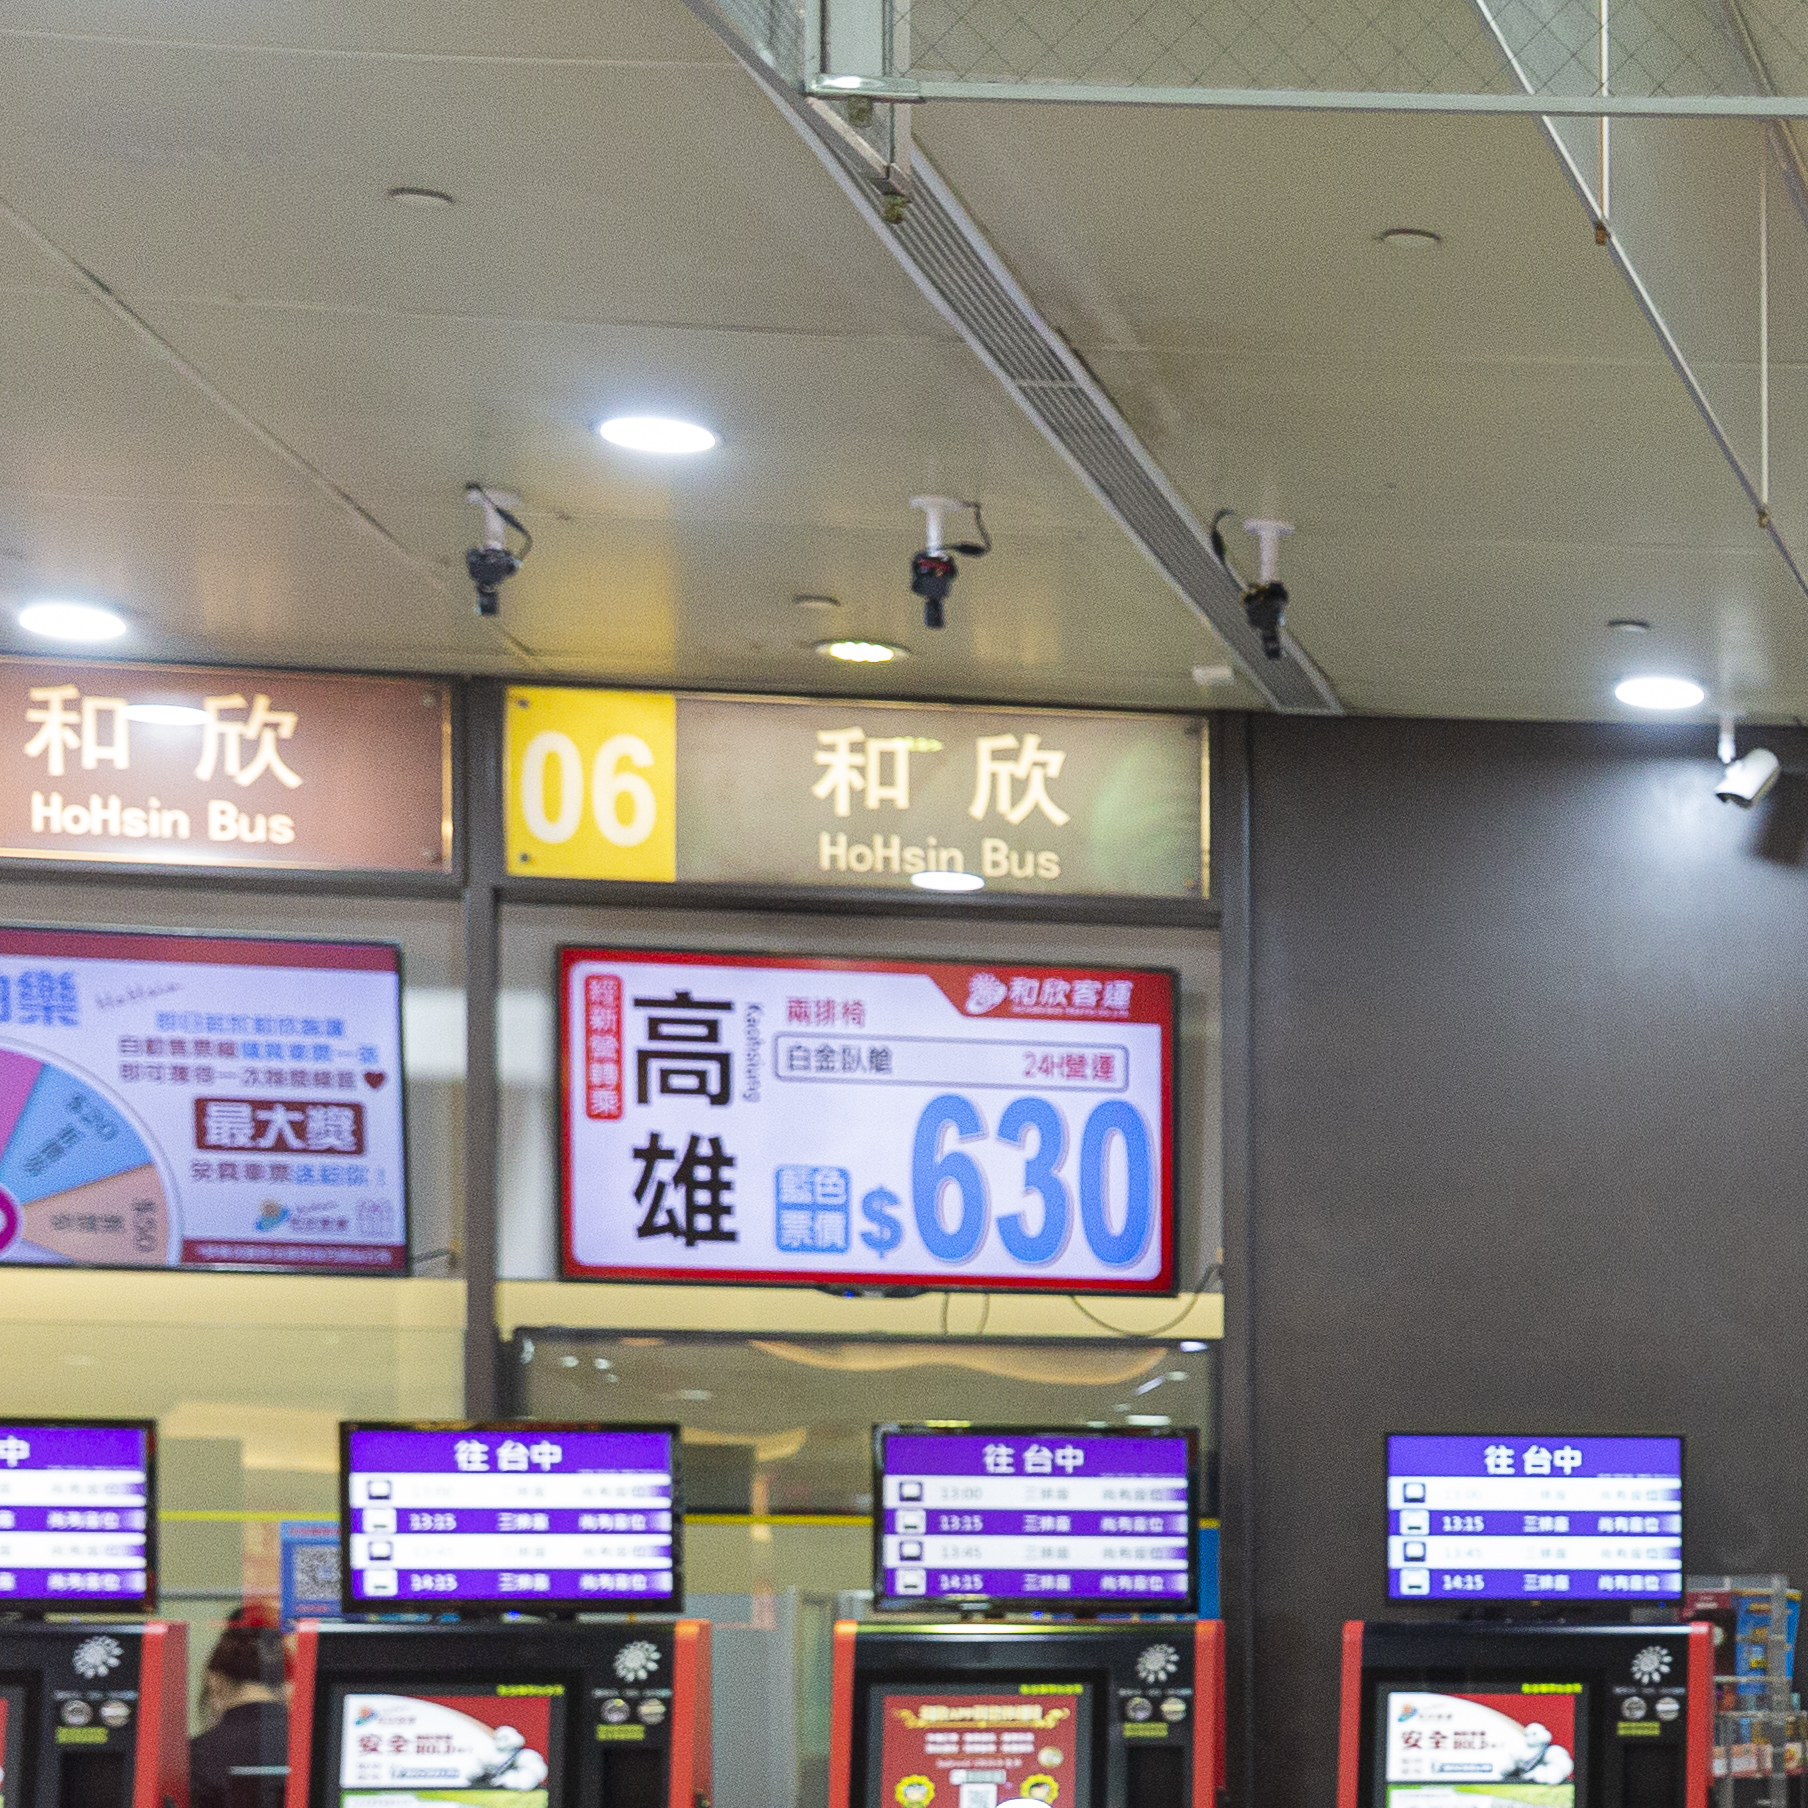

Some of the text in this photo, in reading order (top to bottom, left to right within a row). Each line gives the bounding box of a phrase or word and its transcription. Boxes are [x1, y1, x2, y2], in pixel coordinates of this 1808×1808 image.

[25, 685, 302, 789] 和欣
[812, 727, 1069, 826] 和欣
[31, 793, 294, 844] HoHsin Bus
[521, 730, 657, 847] 06
[820, 833, 1060, 879] HoHsin Bus
[1008, 977, 1133, 1010] 和欣客運
[206, 1102, 356, 1153] 最大獎
[633, 992, 737, 1247] 高雄
[861, 1094, 1156, 1265] $630
